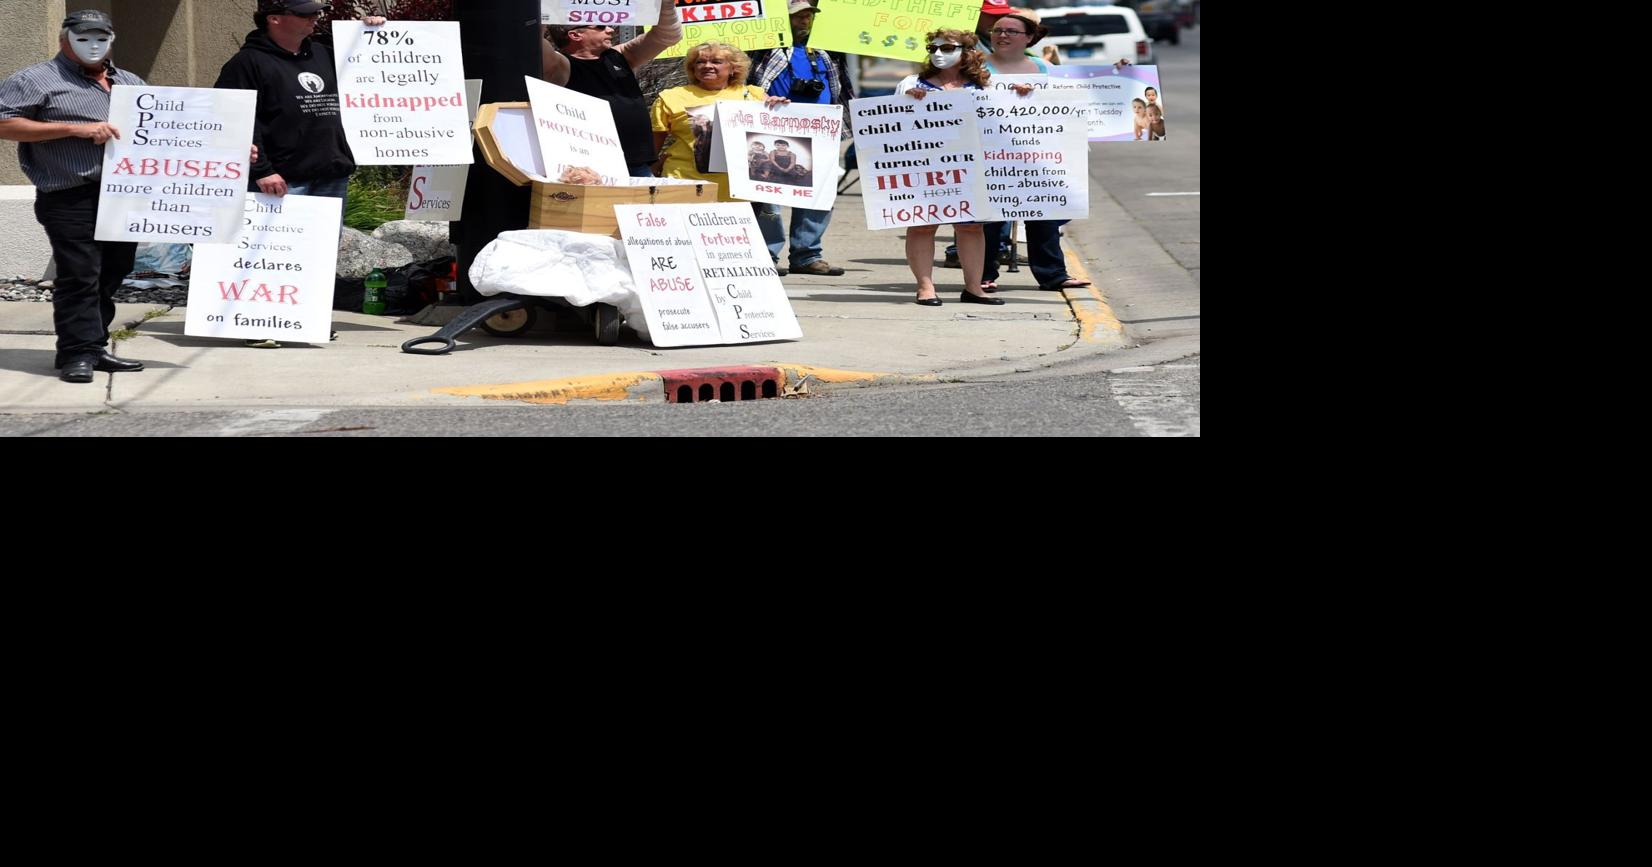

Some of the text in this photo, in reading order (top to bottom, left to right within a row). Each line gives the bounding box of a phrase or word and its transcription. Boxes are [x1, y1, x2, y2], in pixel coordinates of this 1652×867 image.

[568, 10, 630, 23] STOP
[681, 2, 754, 22] KIDS
[712, 16, 786, 37] YOUR
[873, 12, 934, 33] FOR
[363, 30, 414, 46] 78%
[347, 50, 442, 64] of children
[356, 70, 439, 86] are legally
[136, 93, 185, 112] Child
[344, 92, 463, 112] kidnapped
[857, 101, 954, 118] calling the
[373, 114, 403, 123] from
[555, 103, 587, 121] Child
[976, 105, 1087, 119] $30,420,000/yr
[1094, 107, 1123, 117] Tuesday
[138, 111, 223, 132] Protection
[759, 112, 841, 135] Barnosky
[858, 118, 964, 136] child Abuse
[983, 124, 1064, 135] in Montana
[132, 129, 203, 148] Services
[359, 126, 455, 139] non-abusive
[538, 118, 618, 147] PROTECTION
[882, 140, 944, 154] hotline
[1011, 137, 1041, 147] funds
[375, 146, 429, 158] homes
[569, 145, 590, 156] is an
[111, 157, 242, 180] ABUSES
[874, 153, 976, 170] turned OUR
[876, 168, 968, 191] HURT
[984, 166, 1067, 178] children from
[106, 183, 235, 197] more children
[755, 184, 813, 198] ASK ME
[1017, 178, 1069, 190] abusive,
[409, 176, 451, 211] Services
[889, 193, 915, 202] into
[988, 194, 1067, 208] ving, caring
[151, 200, 191, 214] than
[244, 198, 282, 214] Child
[882, 200, 976, 226] HORROR
[1001, 208, 1044, 218] homes
[243, 217, 304, 233] Protective
[636, 212, 667, 227] False
[688, 212, 752, 227] Children are
[128, 219, 213, 237] abusers
[237, 236, 293, 252] Services
[627, 236, 664, 249] allegations
[664, 237, 673, 246] of
[701, 227, 752, 247] tortured
[705, 248, 753, 262] in games of
[233, 257, 303, 272] declares
[651, 256, 678, 272] ARE
[702, 266, 778, 279] RETALIATION
[216, 278, 300, 306] WAR
[650, 276, 695, 292] ABUSE
[715, 283, 753, 306] by Child
[658, 308, 691, 318] prosecute
[206, 313, 303, 330] on families
[662, 321, 710, 331] false accusers
[739, 323, 776, 340] Services
